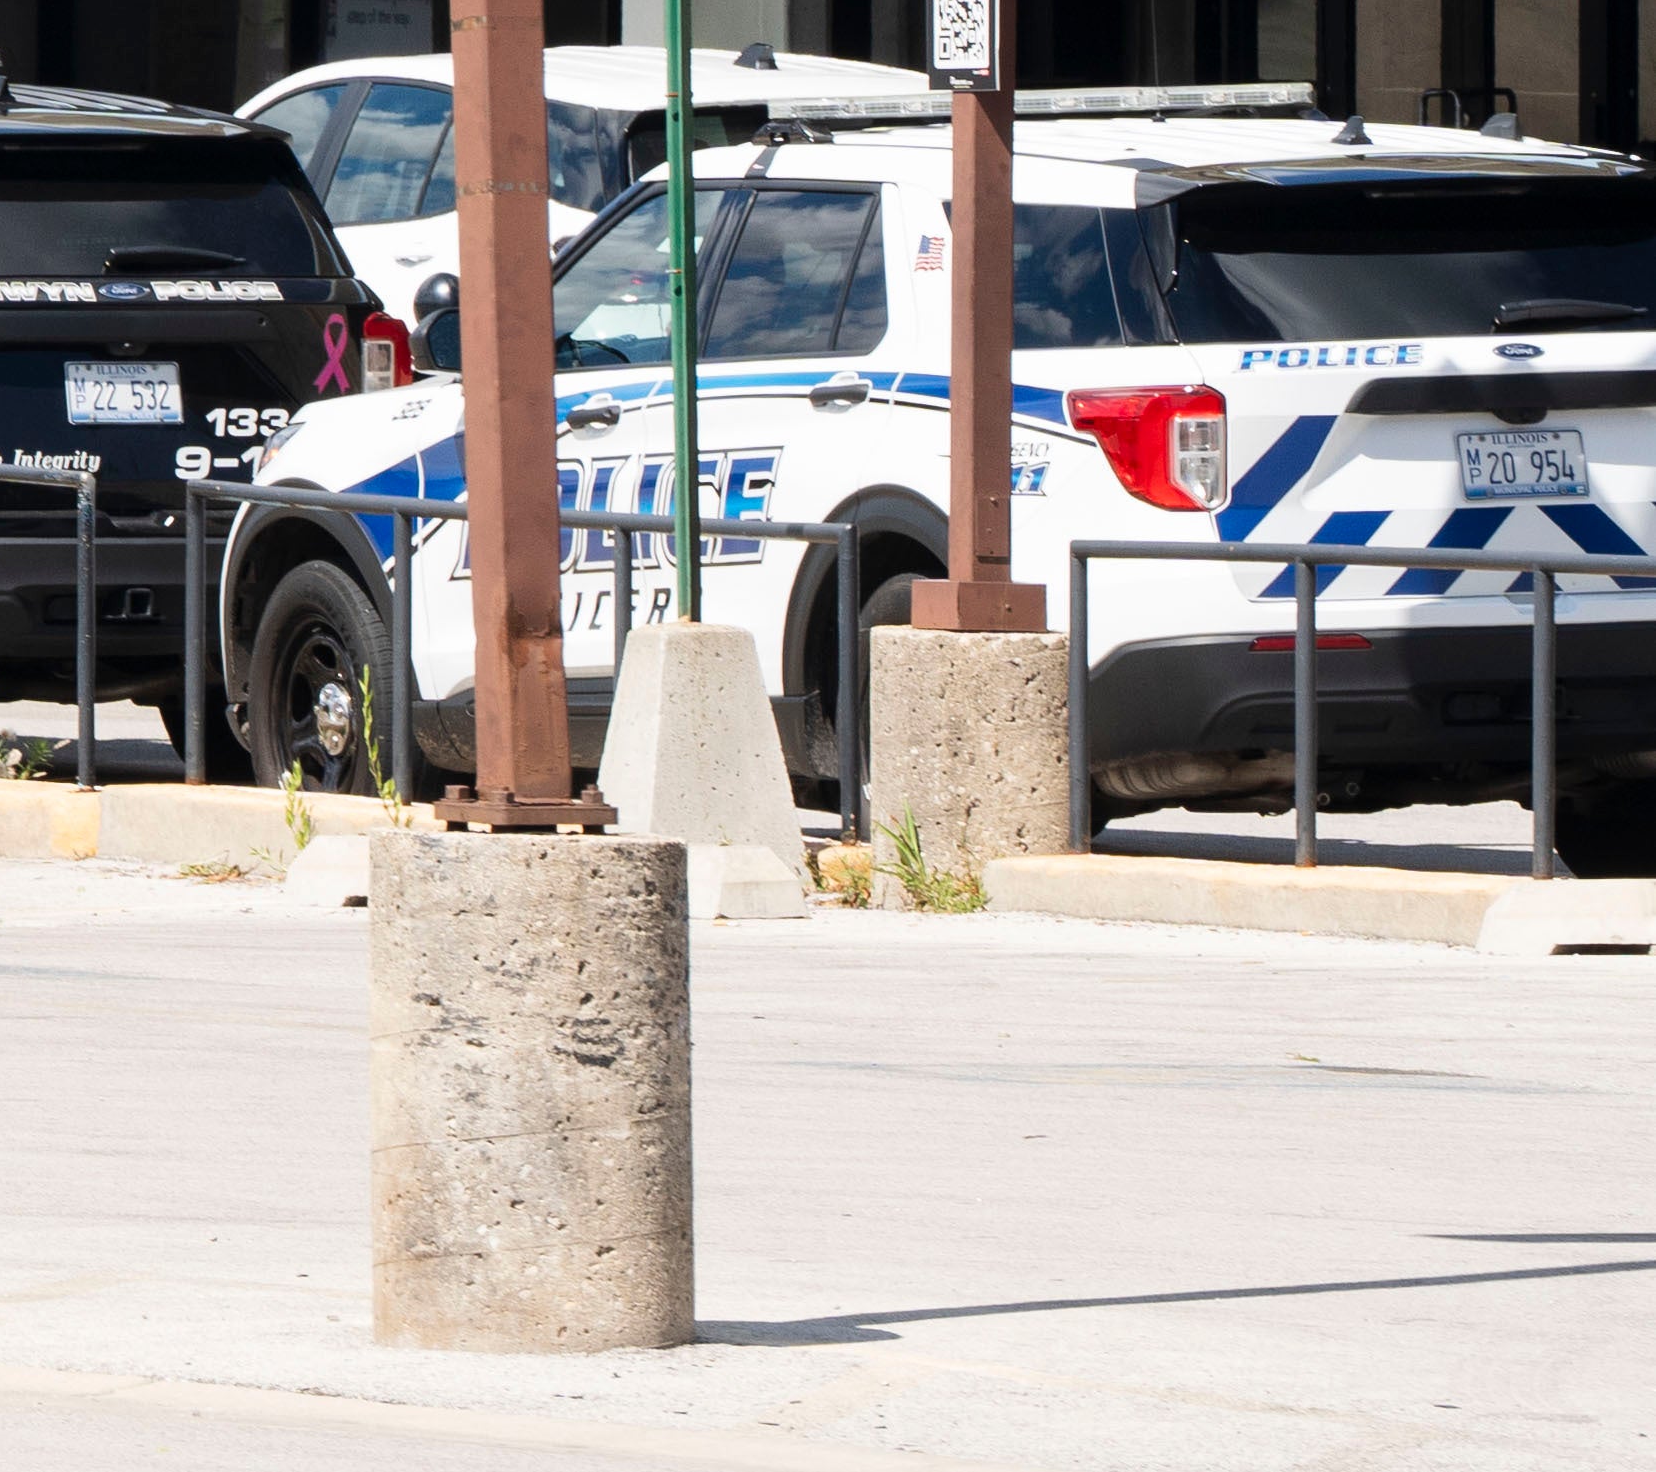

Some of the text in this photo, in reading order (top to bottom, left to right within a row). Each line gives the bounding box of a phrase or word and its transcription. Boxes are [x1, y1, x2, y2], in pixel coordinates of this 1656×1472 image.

[150, 279, 284, 302] POLICE
[96, 365, 148, 375] ILLINOIS
[1238, 343, 1423, 372] POLICE
[93, 379, 172, 411] 22 532
[205, 408, 292, 439] 133
[1491, 433, 1549, 446] ILLINOIS
[13, 449, 102, 474] Integrity
[1486, 449, 1576, 485] 20 954
